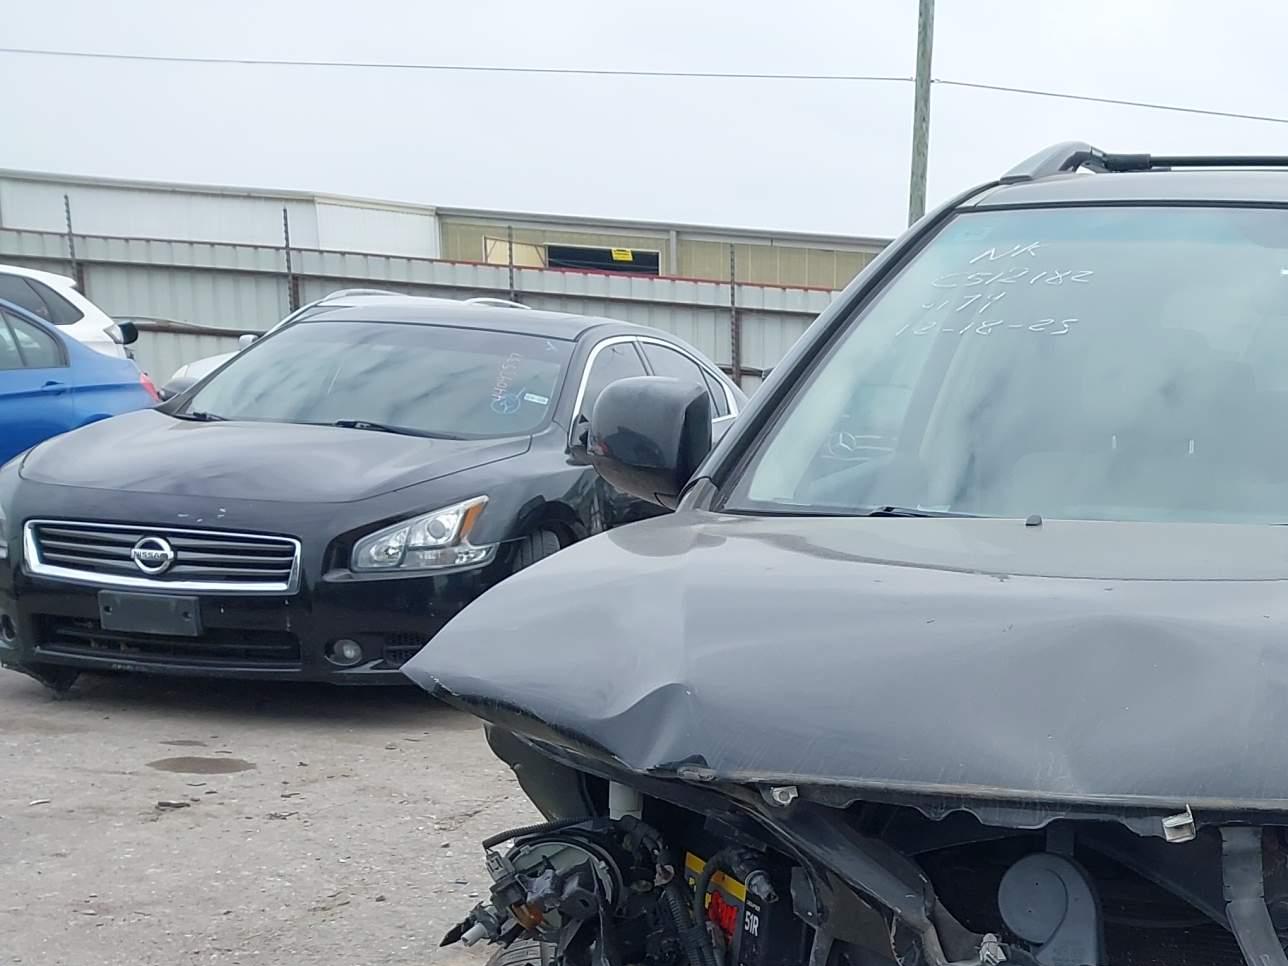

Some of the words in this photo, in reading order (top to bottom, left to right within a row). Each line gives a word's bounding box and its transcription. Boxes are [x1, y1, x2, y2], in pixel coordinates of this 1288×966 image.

[896, 318, 1079, 336] 12-18-25
[134, 551, 169, 560] NISSA
[744, 910, 760, 937] 51R
